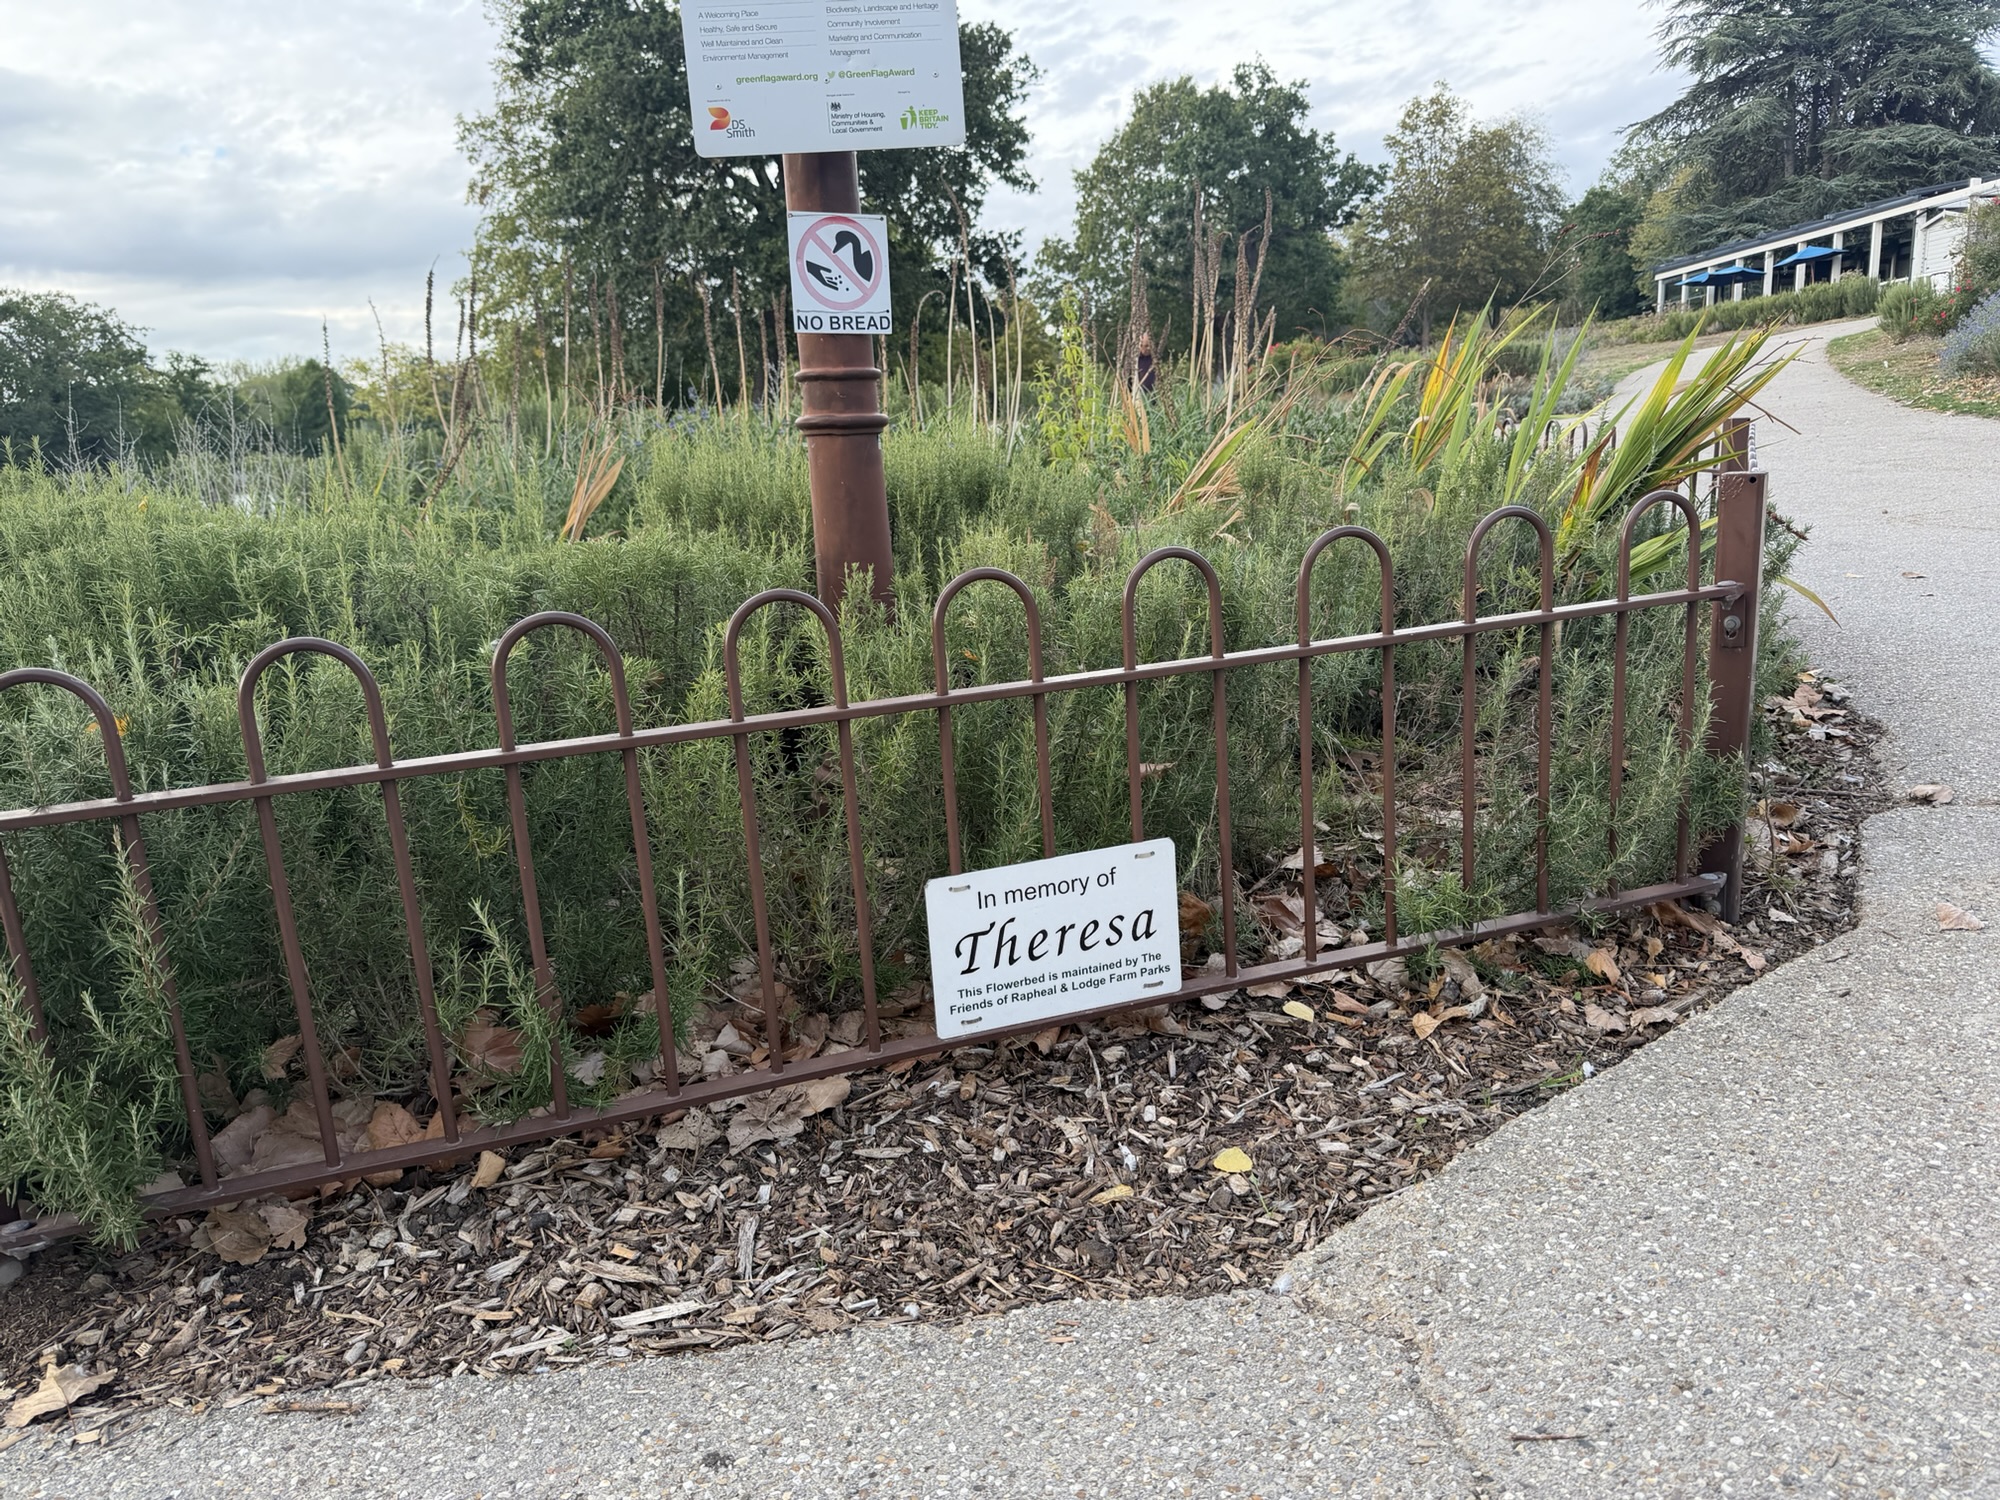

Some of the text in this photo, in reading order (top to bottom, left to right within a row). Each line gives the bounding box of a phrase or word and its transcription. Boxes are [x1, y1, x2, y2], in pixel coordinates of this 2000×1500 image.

[864, 4, 898, 12] Landscape
[704, 11, 740, 19] Welcoming
[827, 20, 862, 28] Community
[700, 26, 724, 34] Healthy,
[828, 34, 859, 42] Marketing
[874, 32, 921, 40] Communication
[716, 39, 749, 47] Maintained
[703, 52, 788, 62] Environmental Management
[830, 48, 870, 57] Management
[838, 68, 915, 78] @GreenFlagAward
[736, 73, 818, 85] greenflagaward.org
[861, 111, 885, 119] Housing,
[732, 119, 745, 129] DS
[831, 119, 868, 127] Communities
[726, 127, 755, 138] Smith
[797, 315, 890, 330] NO BREAD
[977, 866, 1116, 910] In memory of
[955, 908, 1157, 975] Theresa
[957, 952, 1162, 999] This Flowerbed is maintained by The
[950, 964, 1171, 1015] Friends of Rapheal & Lodge Farm Parks
